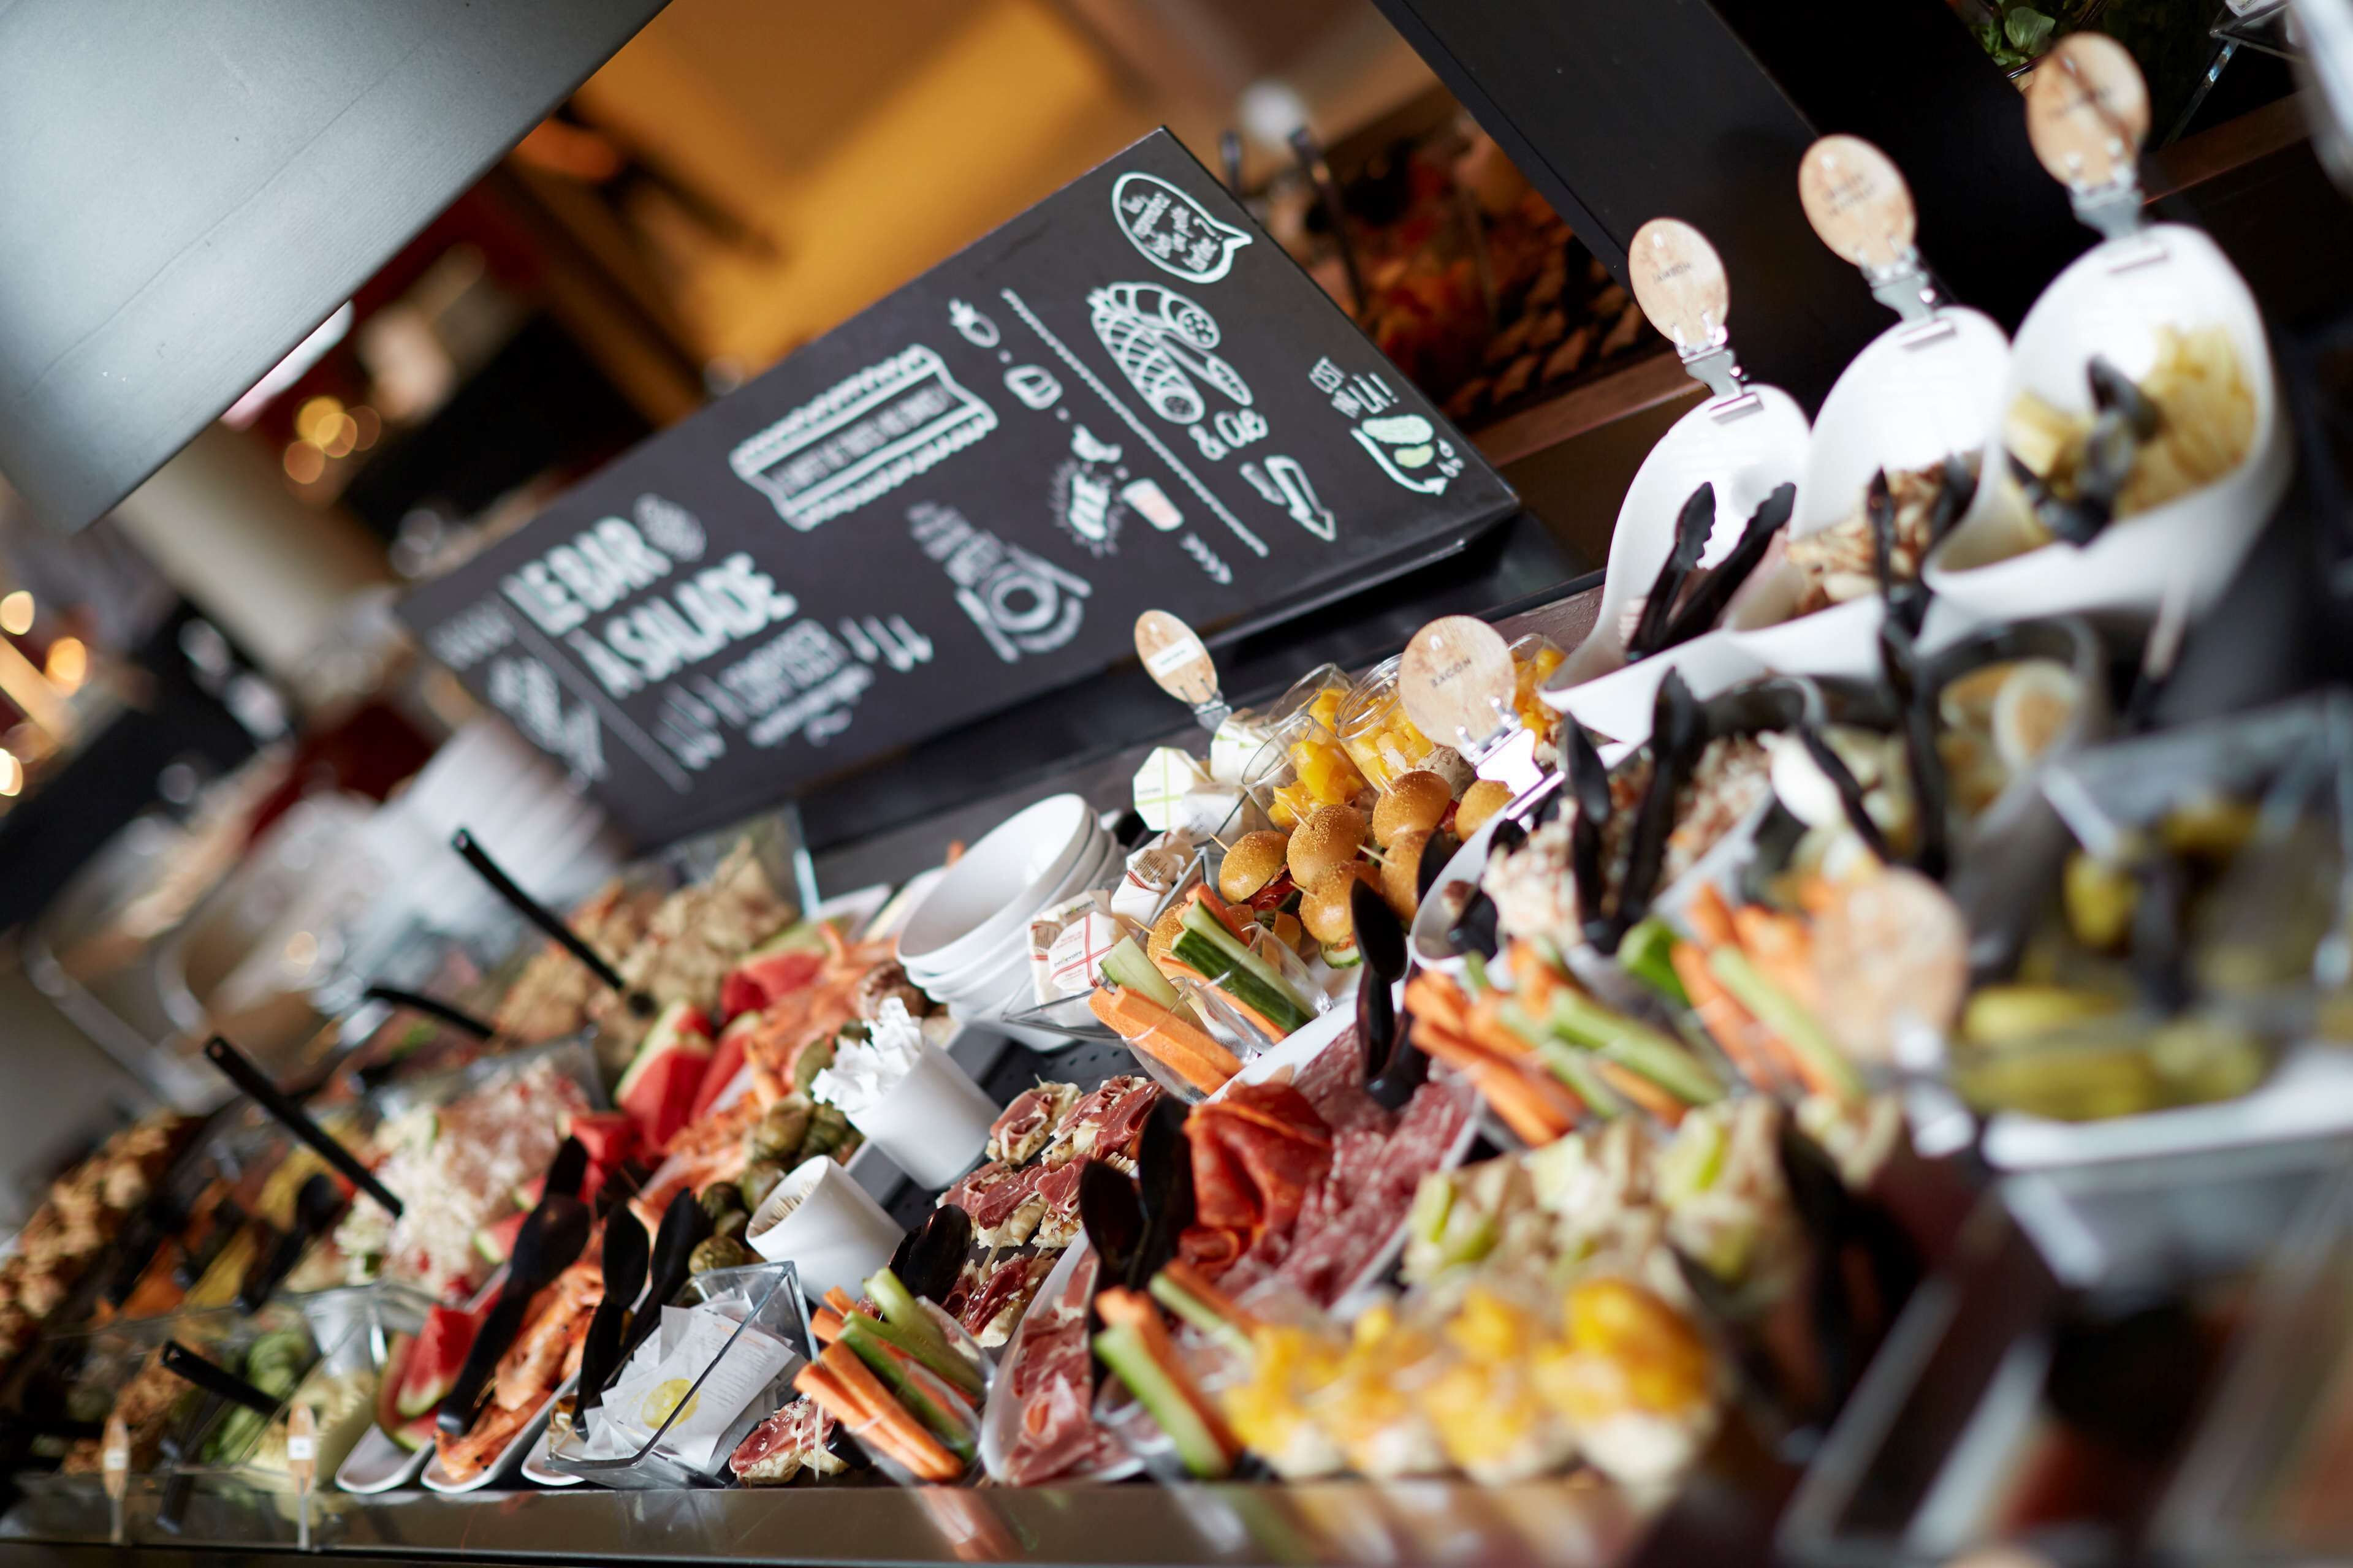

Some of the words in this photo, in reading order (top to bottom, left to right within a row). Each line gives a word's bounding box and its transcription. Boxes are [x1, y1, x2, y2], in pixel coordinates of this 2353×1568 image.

[1187, 423, 1231, 461] &
[544, 515, 673, 612] BAR
[499, 570, 590, 637] LE
[604, 550, 800, 683] SALADE
[1431, 657, 1472, 688] BACON
